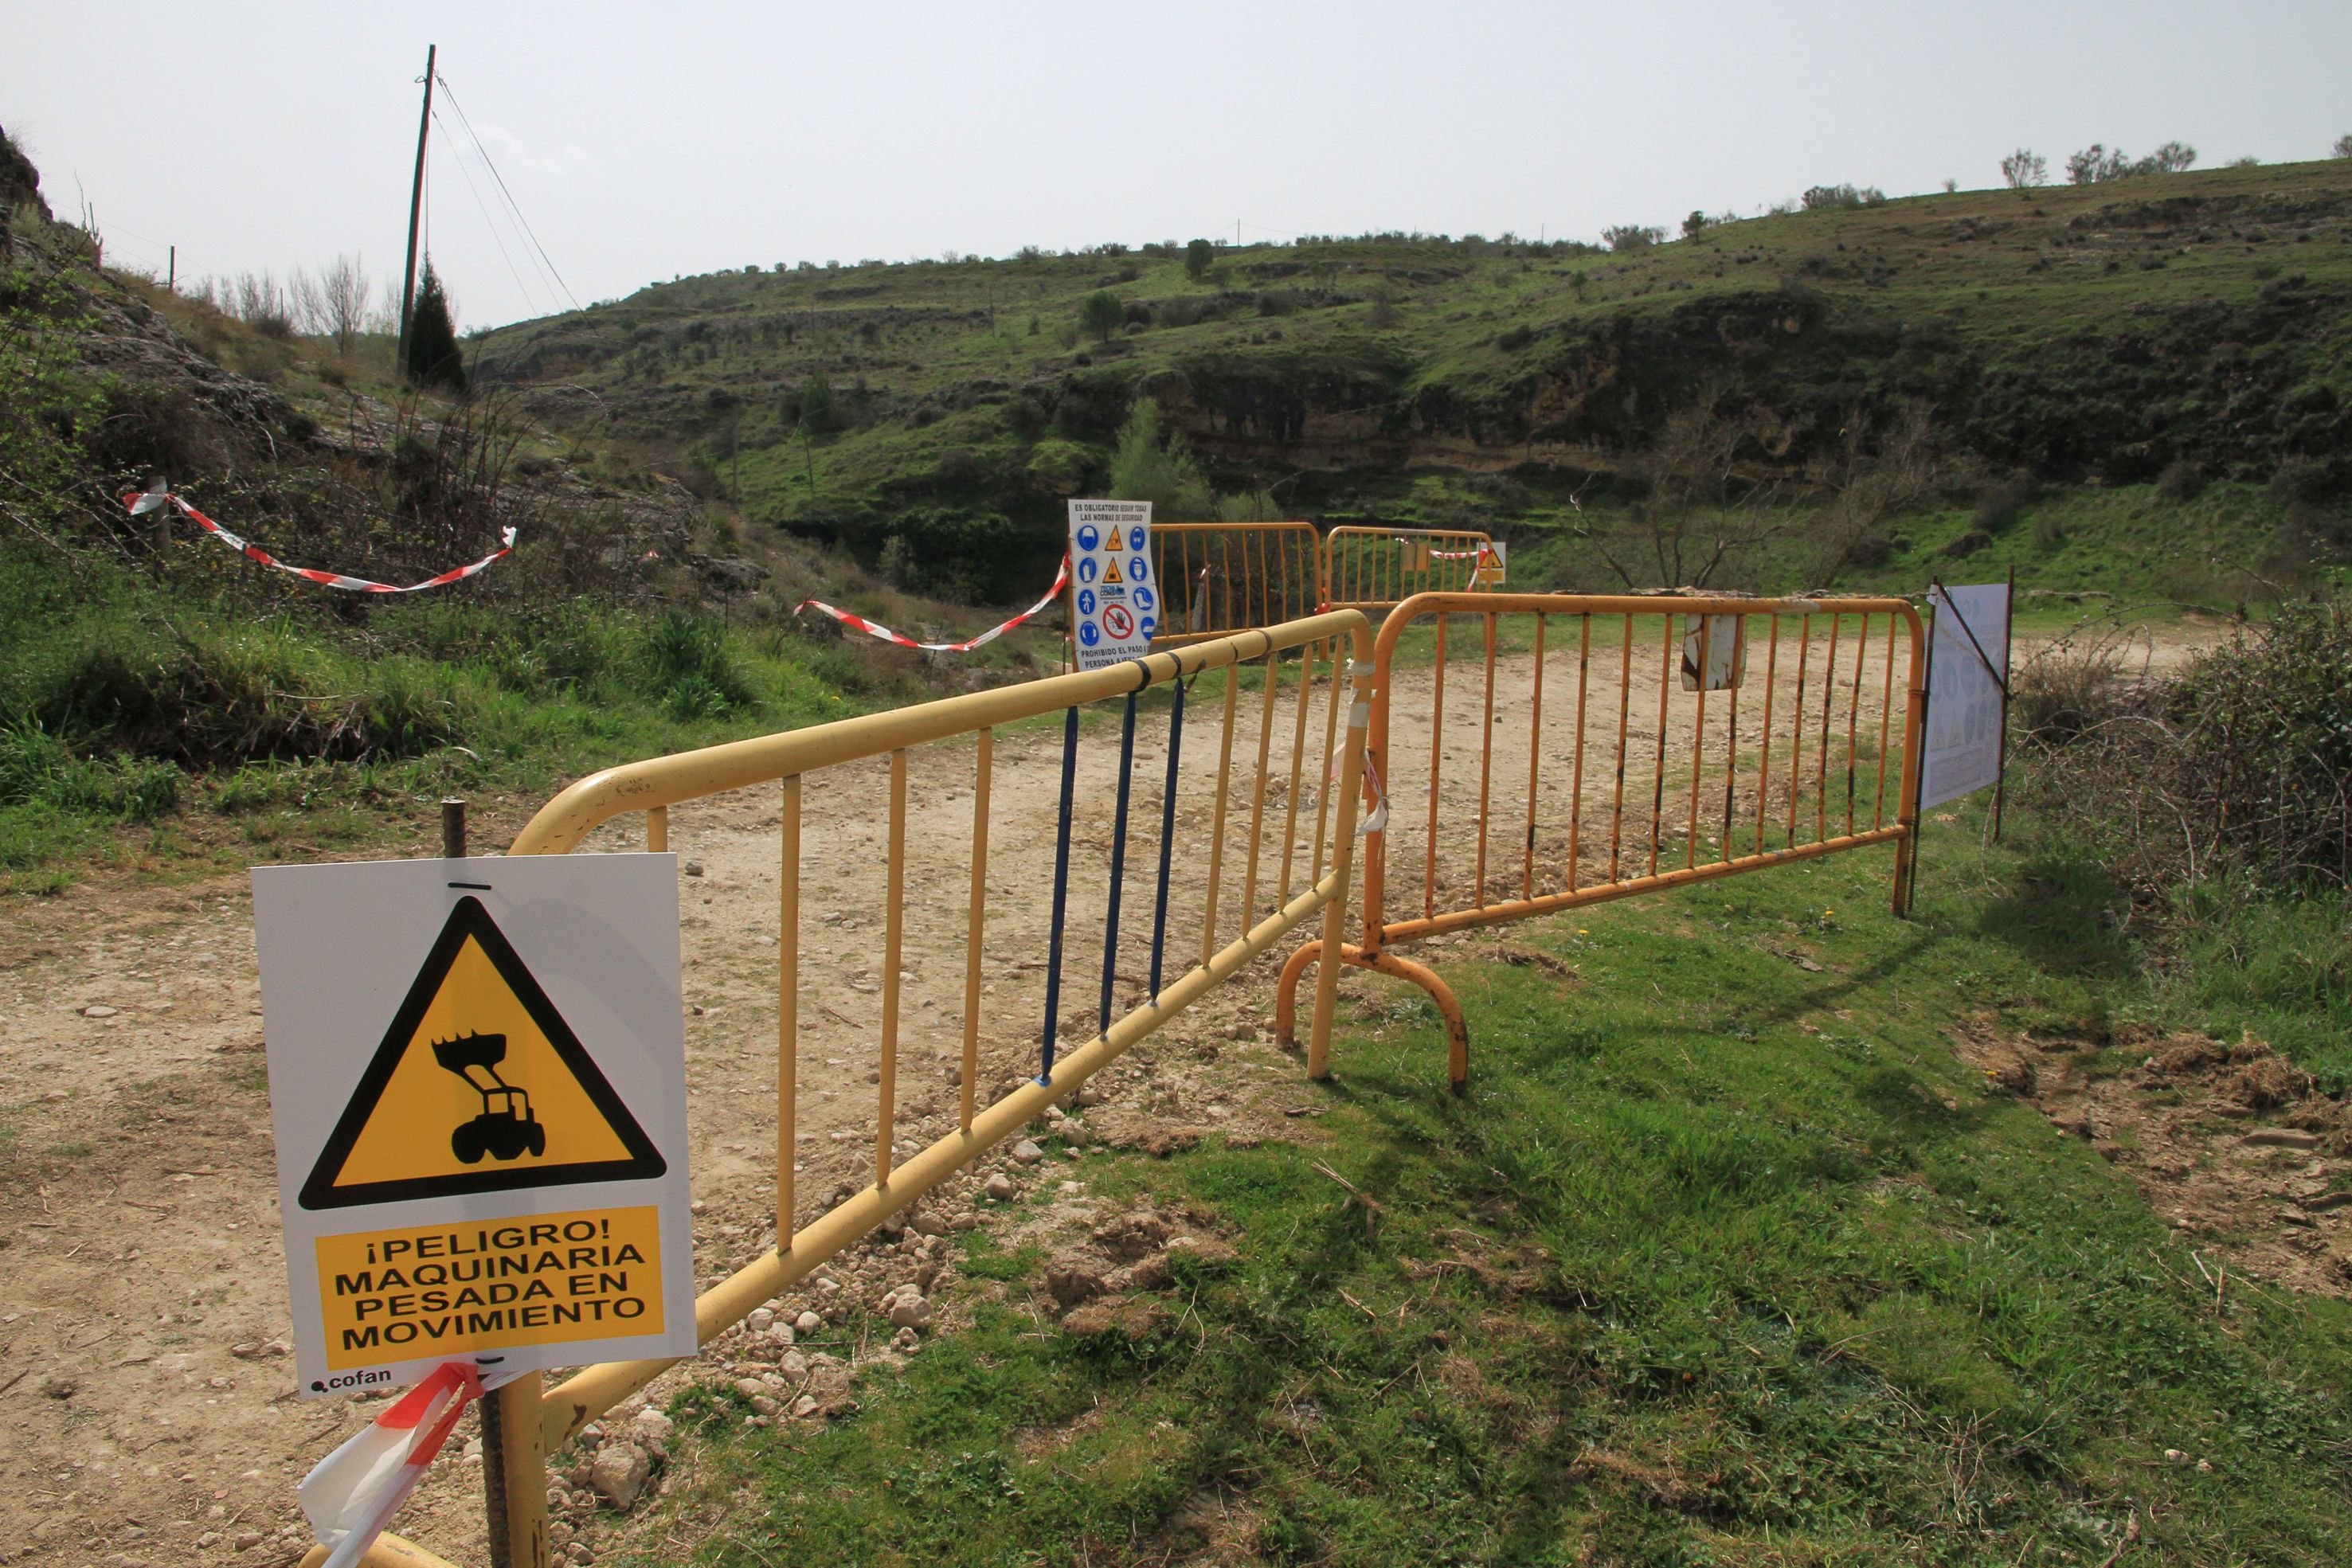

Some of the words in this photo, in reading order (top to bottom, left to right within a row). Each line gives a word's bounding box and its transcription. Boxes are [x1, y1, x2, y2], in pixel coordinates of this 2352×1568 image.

[1081, 648, 1117, 658] PROHIBIDO
[1085, 658, 1116, 668] PERSONA
[366, 1218, 610, 1265] ¡PELIGRO!
[335, 1244, 646, 1296] MAQUINARIA
[355, 1279, 555, 1321] PESADA
[569, 1271, 628, 1296] EN
[342, 1297, 646, 1351] MOVIMIENTO
[328, 1369, 392, 1390] cofan
